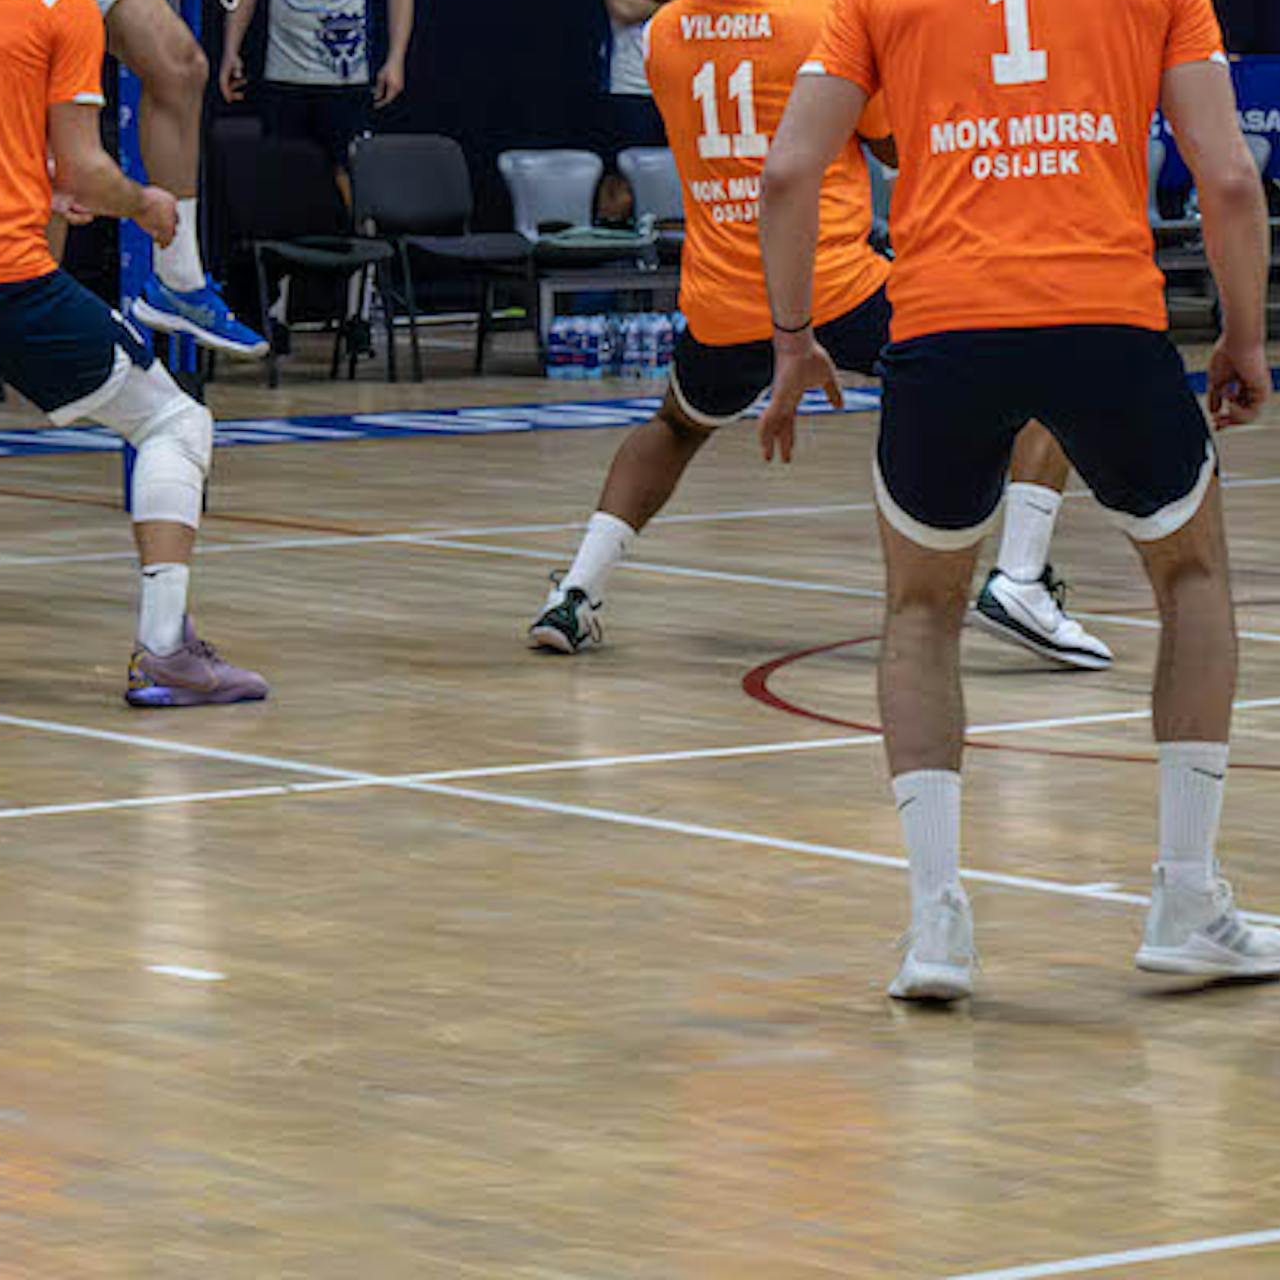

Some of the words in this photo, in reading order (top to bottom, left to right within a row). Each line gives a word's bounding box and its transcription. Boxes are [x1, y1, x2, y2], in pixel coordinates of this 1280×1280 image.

[680, 12, 773, 40] VILORIA
[692, 59, 770, 159] 11
[930, 117, 1001, 154] MOK
[1008, 112, 1118, 145] MURSA
[972, 150, 1081, 180] OSIJEK
